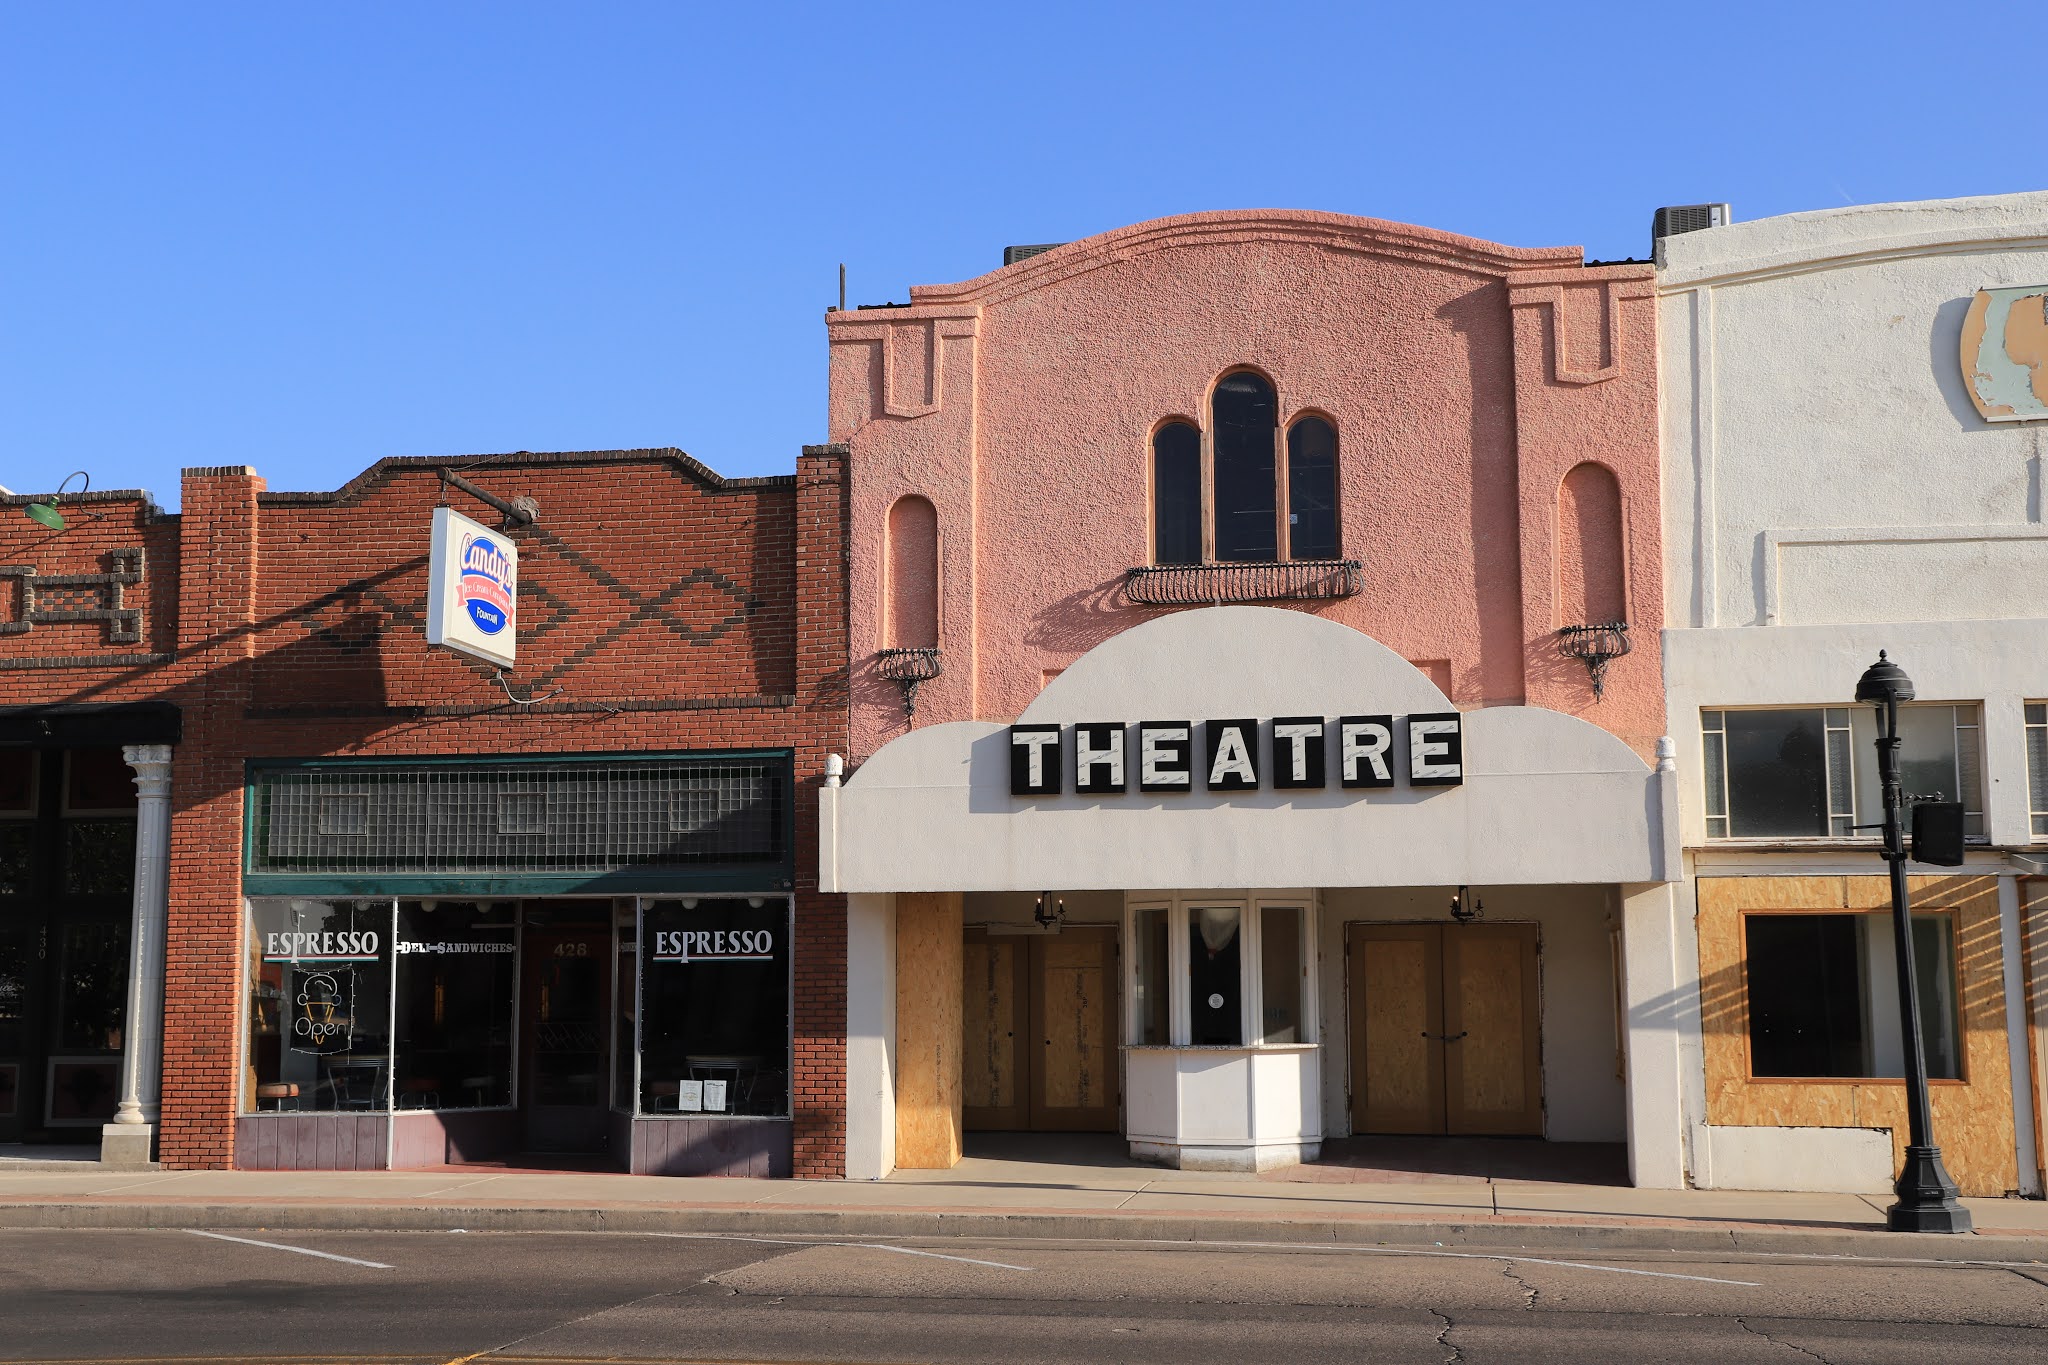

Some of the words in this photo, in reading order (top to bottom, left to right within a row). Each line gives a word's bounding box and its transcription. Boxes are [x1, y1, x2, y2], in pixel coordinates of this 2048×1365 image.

[459, 532, 513, 591] Candy's
[476, 606, 498, 625] FOUNTAIN
[1012, 719, 1461, 788] THEATRE
[267, 931, 379, 964] ESPRESSO
[553, 942, 588, 957] 428
[656, 929, 773, 963] ESPRESSO
[295, 1016, 347, 1040] Open
